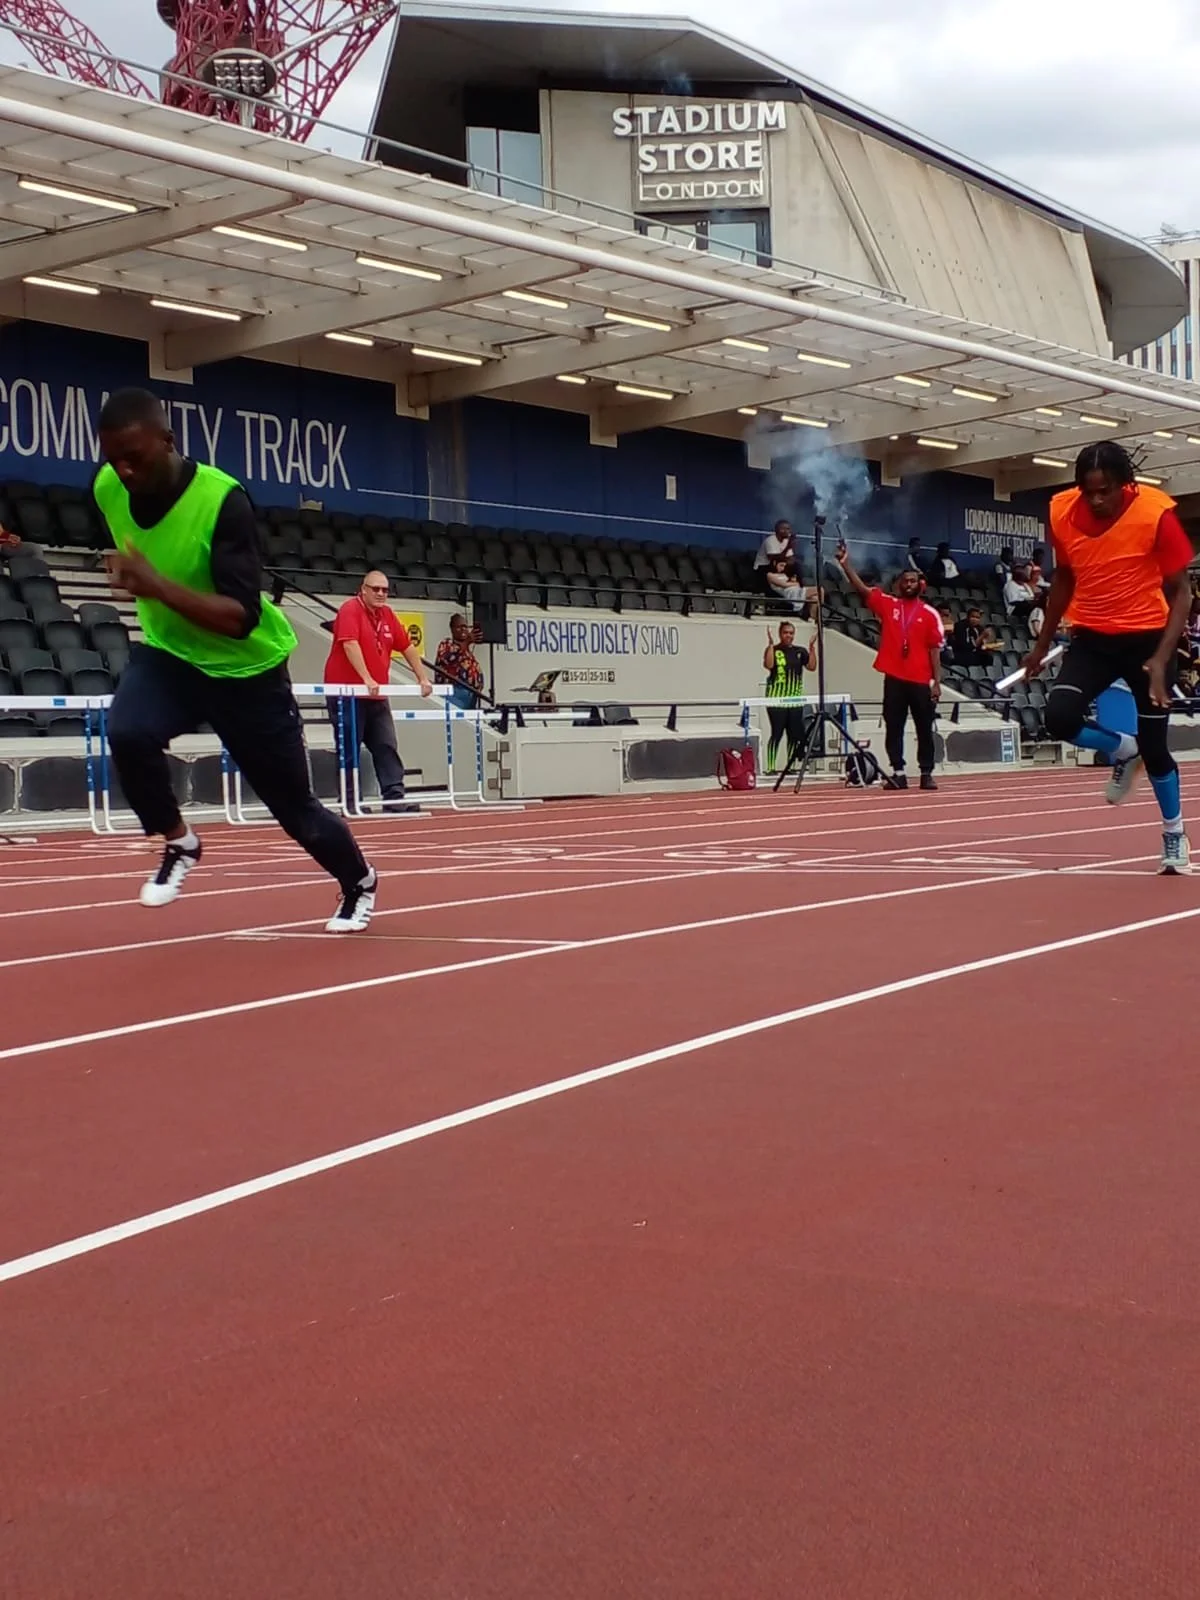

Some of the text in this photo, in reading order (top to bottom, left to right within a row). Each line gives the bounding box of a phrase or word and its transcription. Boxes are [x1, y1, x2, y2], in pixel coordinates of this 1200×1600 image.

[612, 101, 786, 136] STADIUM
[638, 139, 763, 173] STORE
[639, 179, 763, 200] LONDON
[236, 410, 350, 490] TRACK
[964, 508, 1039, 538] LONDON MARATHON
[1013, 537, 1034, 559] TRUST
[516, 620, 588, 653] BRASHER
[591, 622, 639, 654] DISLEY
[640, 625, 679, 655] STAND
